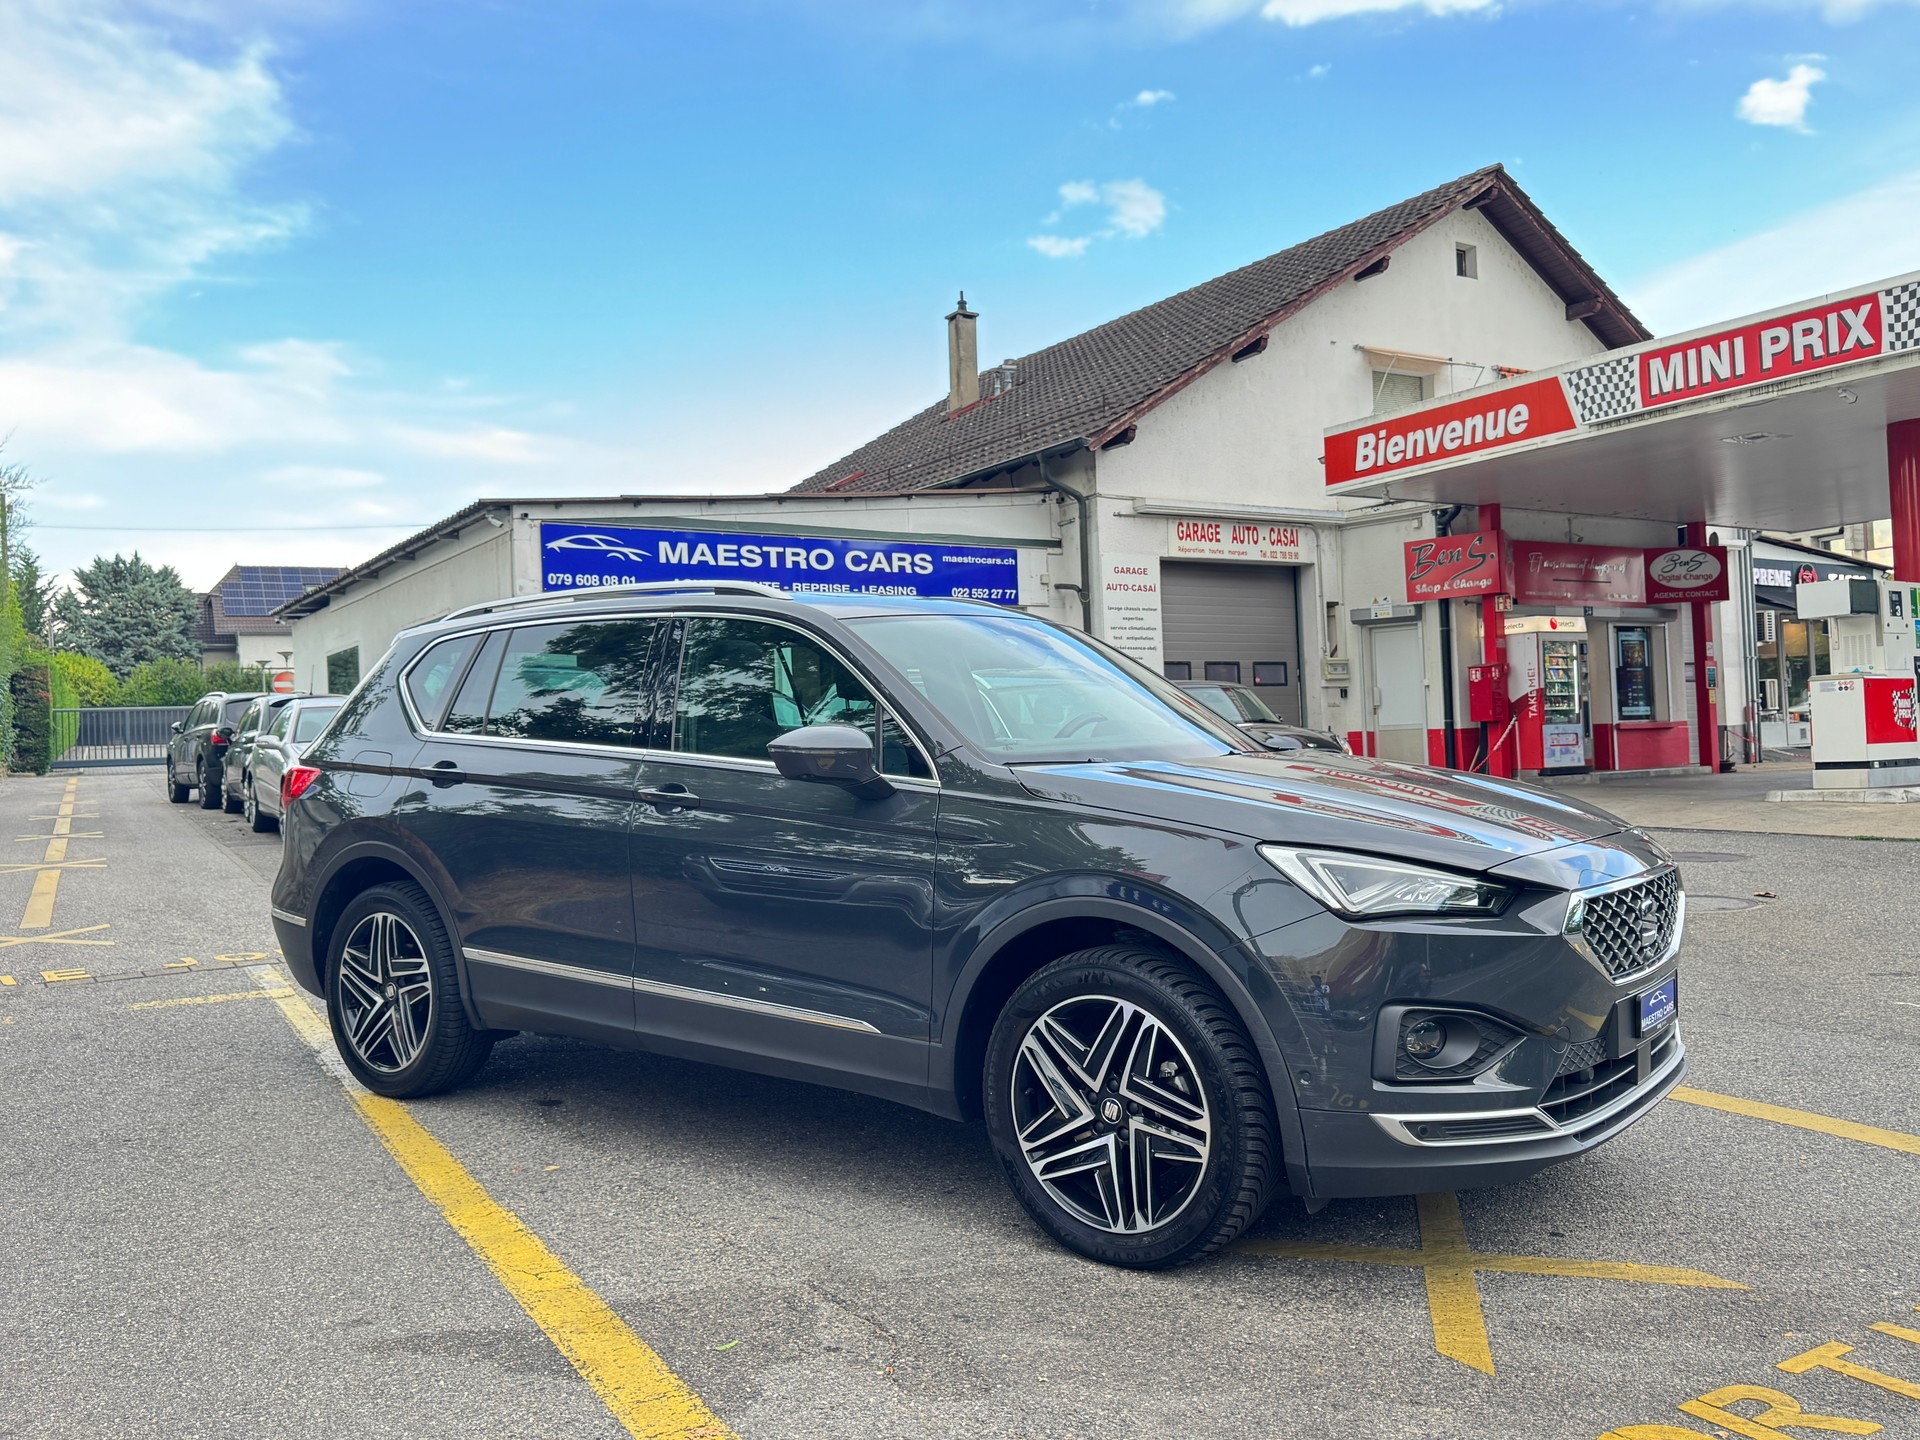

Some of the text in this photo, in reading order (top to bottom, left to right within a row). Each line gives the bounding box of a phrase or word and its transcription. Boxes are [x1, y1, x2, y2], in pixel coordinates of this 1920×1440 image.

[1648, 301, 1876, 398] MINI PRIX
[1355, 402, 1529, 473] Bienvenue
[1177, 521, 1221, 543] GARAGE
[1231, 525, 1259, 545] AUTO
[659, 540, 933, 575] MAESTRO CARS
[1208, 547, 1224, 555] toutes
[942, 554, 1015, 566] maestrocars.ch
[1408, 542, 1462, 581] Ben
[1113, 566, 1148, 575] GARAGE
[547, 573, 636, 586] 079 608 08 01
[1658, 573, 1681, 583] Digital
[792, 583, 850, 593] REPRISE
[861, 585, 917, 596] LEASING
[1415, 578, 1492, 594] Shop & Change
[951, 587, 1017, 600] 022 552 27 77
[1654, 590, 1719, 599] AGENCE CONTACT
[1895, 605, 1901, 616] 3
[1527, 668, 1538, 718] TAKE ME!
[1898, 708, 1912, 719] PRIX
[1641, 1008, 1663, 1028] MAESTRO
[1663, 1000, 1674, 1015] CARS
